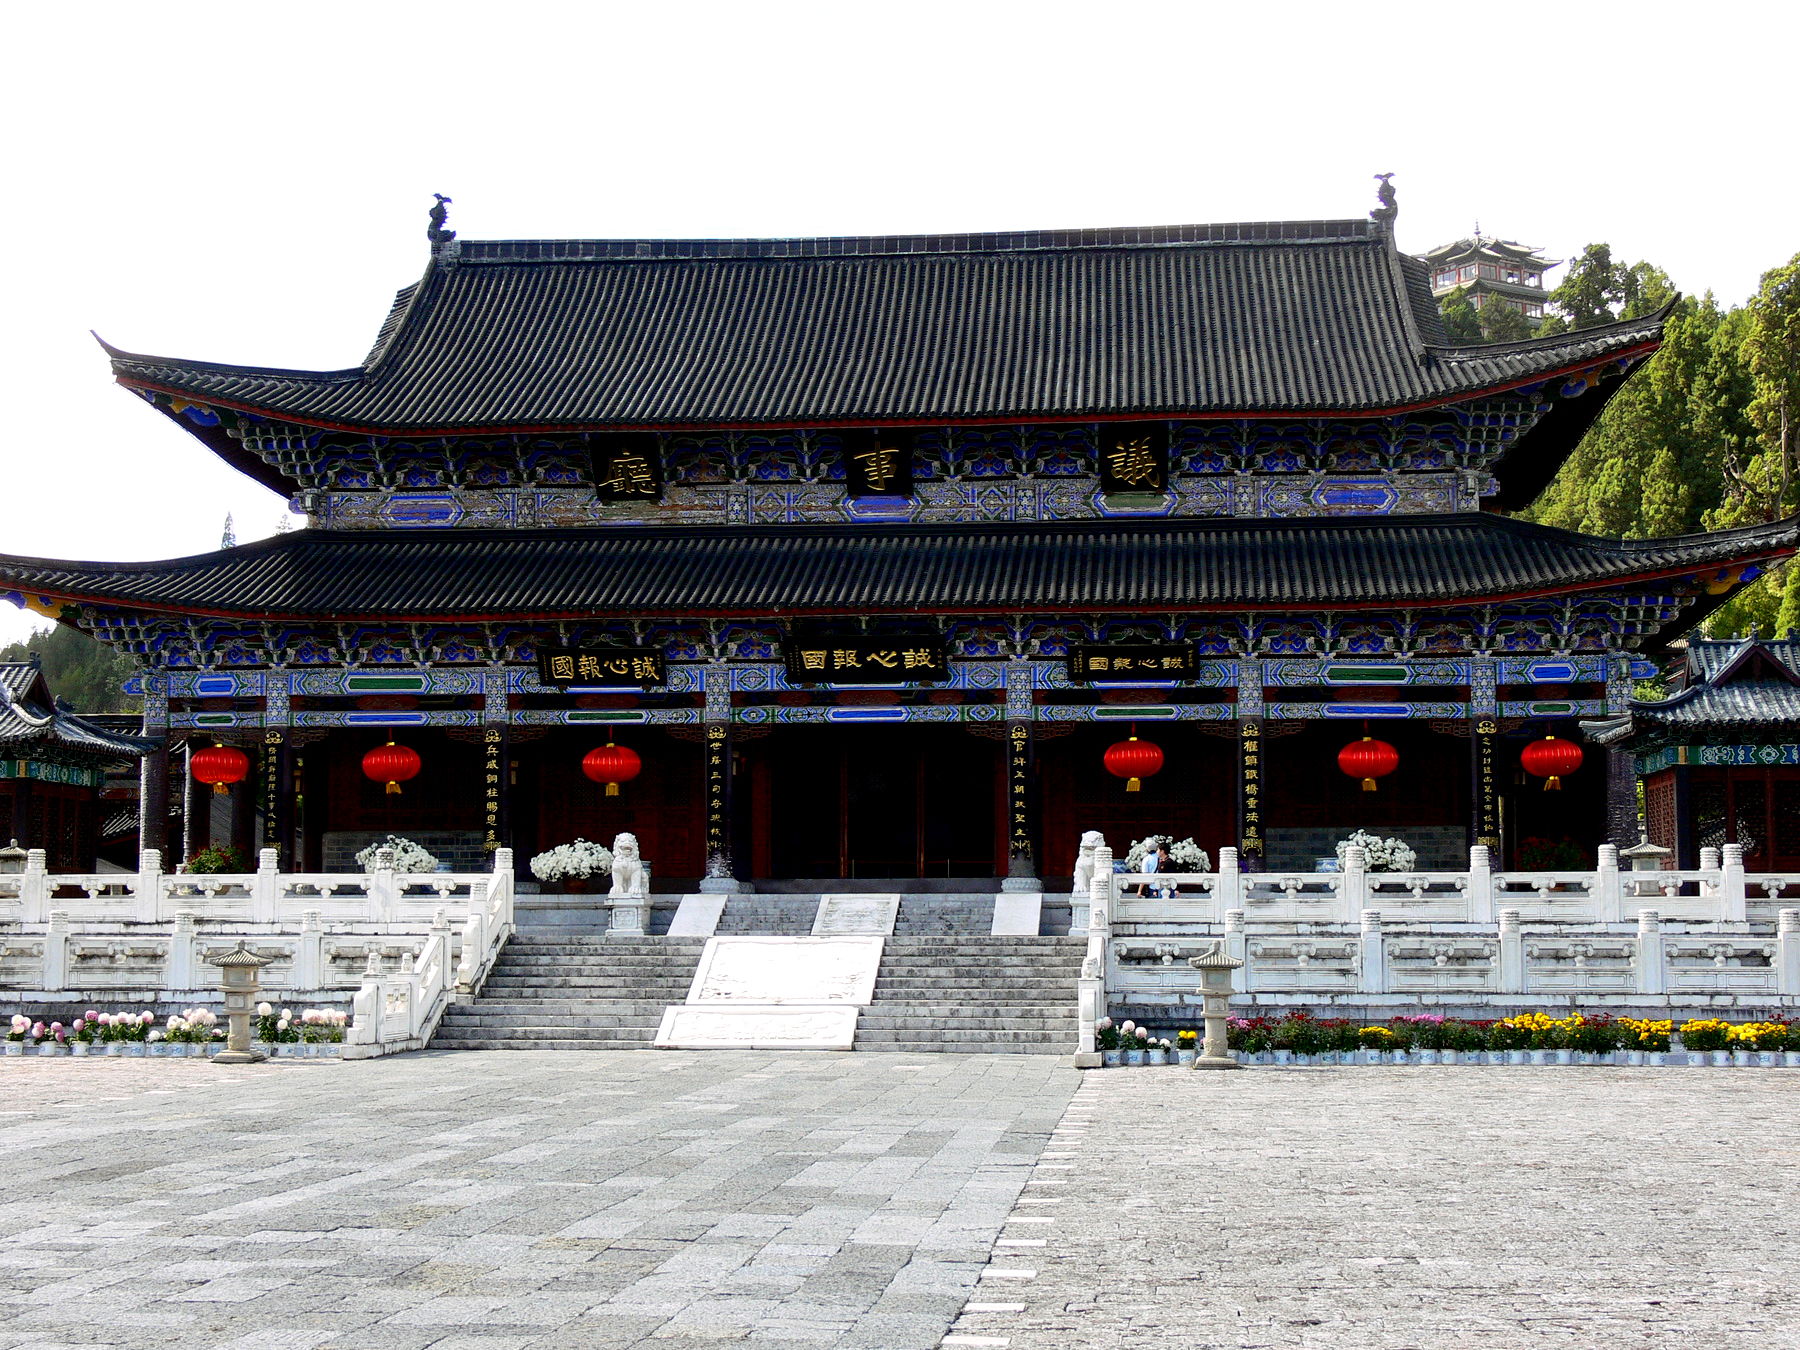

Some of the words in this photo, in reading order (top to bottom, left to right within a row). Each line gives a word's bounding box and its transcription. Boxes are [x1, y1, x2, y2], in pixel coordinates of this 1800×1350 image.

[598, 447, 657, 494] 廳
[853, 441, 900, 491] 事
[1106, 436, 1161, 488] 議
